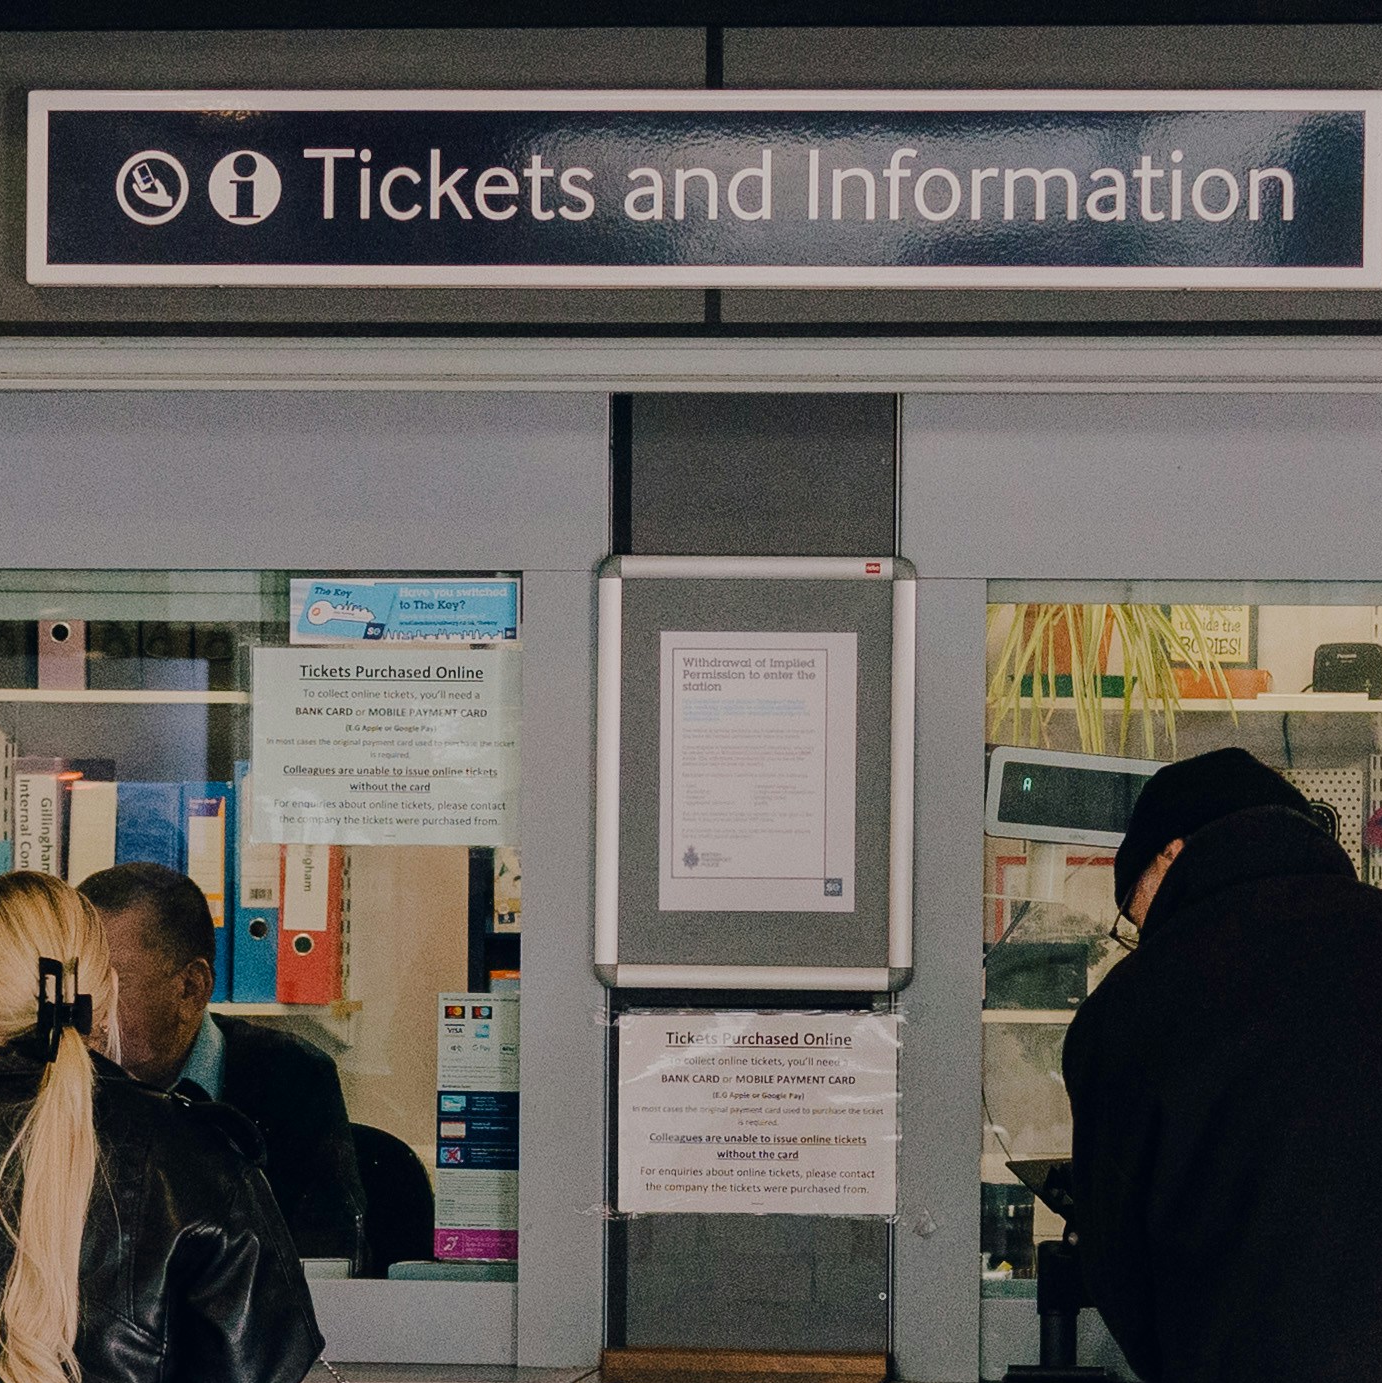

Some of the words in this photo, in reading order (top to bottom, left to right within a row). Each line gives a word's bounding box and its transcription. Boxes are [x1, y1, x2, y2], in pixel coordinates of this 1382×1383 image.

[303, 148, 595, 223] Tickets
[622, 150, 772, 223] and
[808, 147, 1294, 223] Information
[314, 587, 331, 595] The
[333, 588, 352, 599] Key
[400, 600, 410, 609] to
[413, 600, 434, 609] The
[437, 600, 466, 612] Key?
[682, 657, 752, 668] Withdrawal
[754, 658, 767, 668] of
[769, 658, 815, 669] Implied
[299, 664, 351, 679] Tickets
[355, 665, 431, 679] Purchased
[435, 665, 484, 679] Online
[682, 669, 746, 680] Permission
[748, 669, 761, 680] to
[763, 671, 793, 680] enter
[796, 669, 817, 681] the
[682, 681, 722, 693] station
[349, 781, 388, 792] without
[390, 782, 408, 793] the
[409, 782, 431, 793] card
[19, 779, 31, 836] Internal
[38, 797, 53, 874] Gillingham
[666, 1032, 717, 1044] Tickets
[722, 1032, 798, 1045] Purchased
[804, 1032, 852, 1046] Online
[662, 1075, 689, 1083] BANK
[692, 1075, 720, 1084] CARD
[736, 1075, 774, 1084] MOBILE
[777, 1076, 825, 1084] PAYMENT
[828, 1076, 856, 1085] CARD
[718, 1150, 756, 1159] without
[759, 1150, 774, 1159] the
[777, 1151, 799, 1159] card
